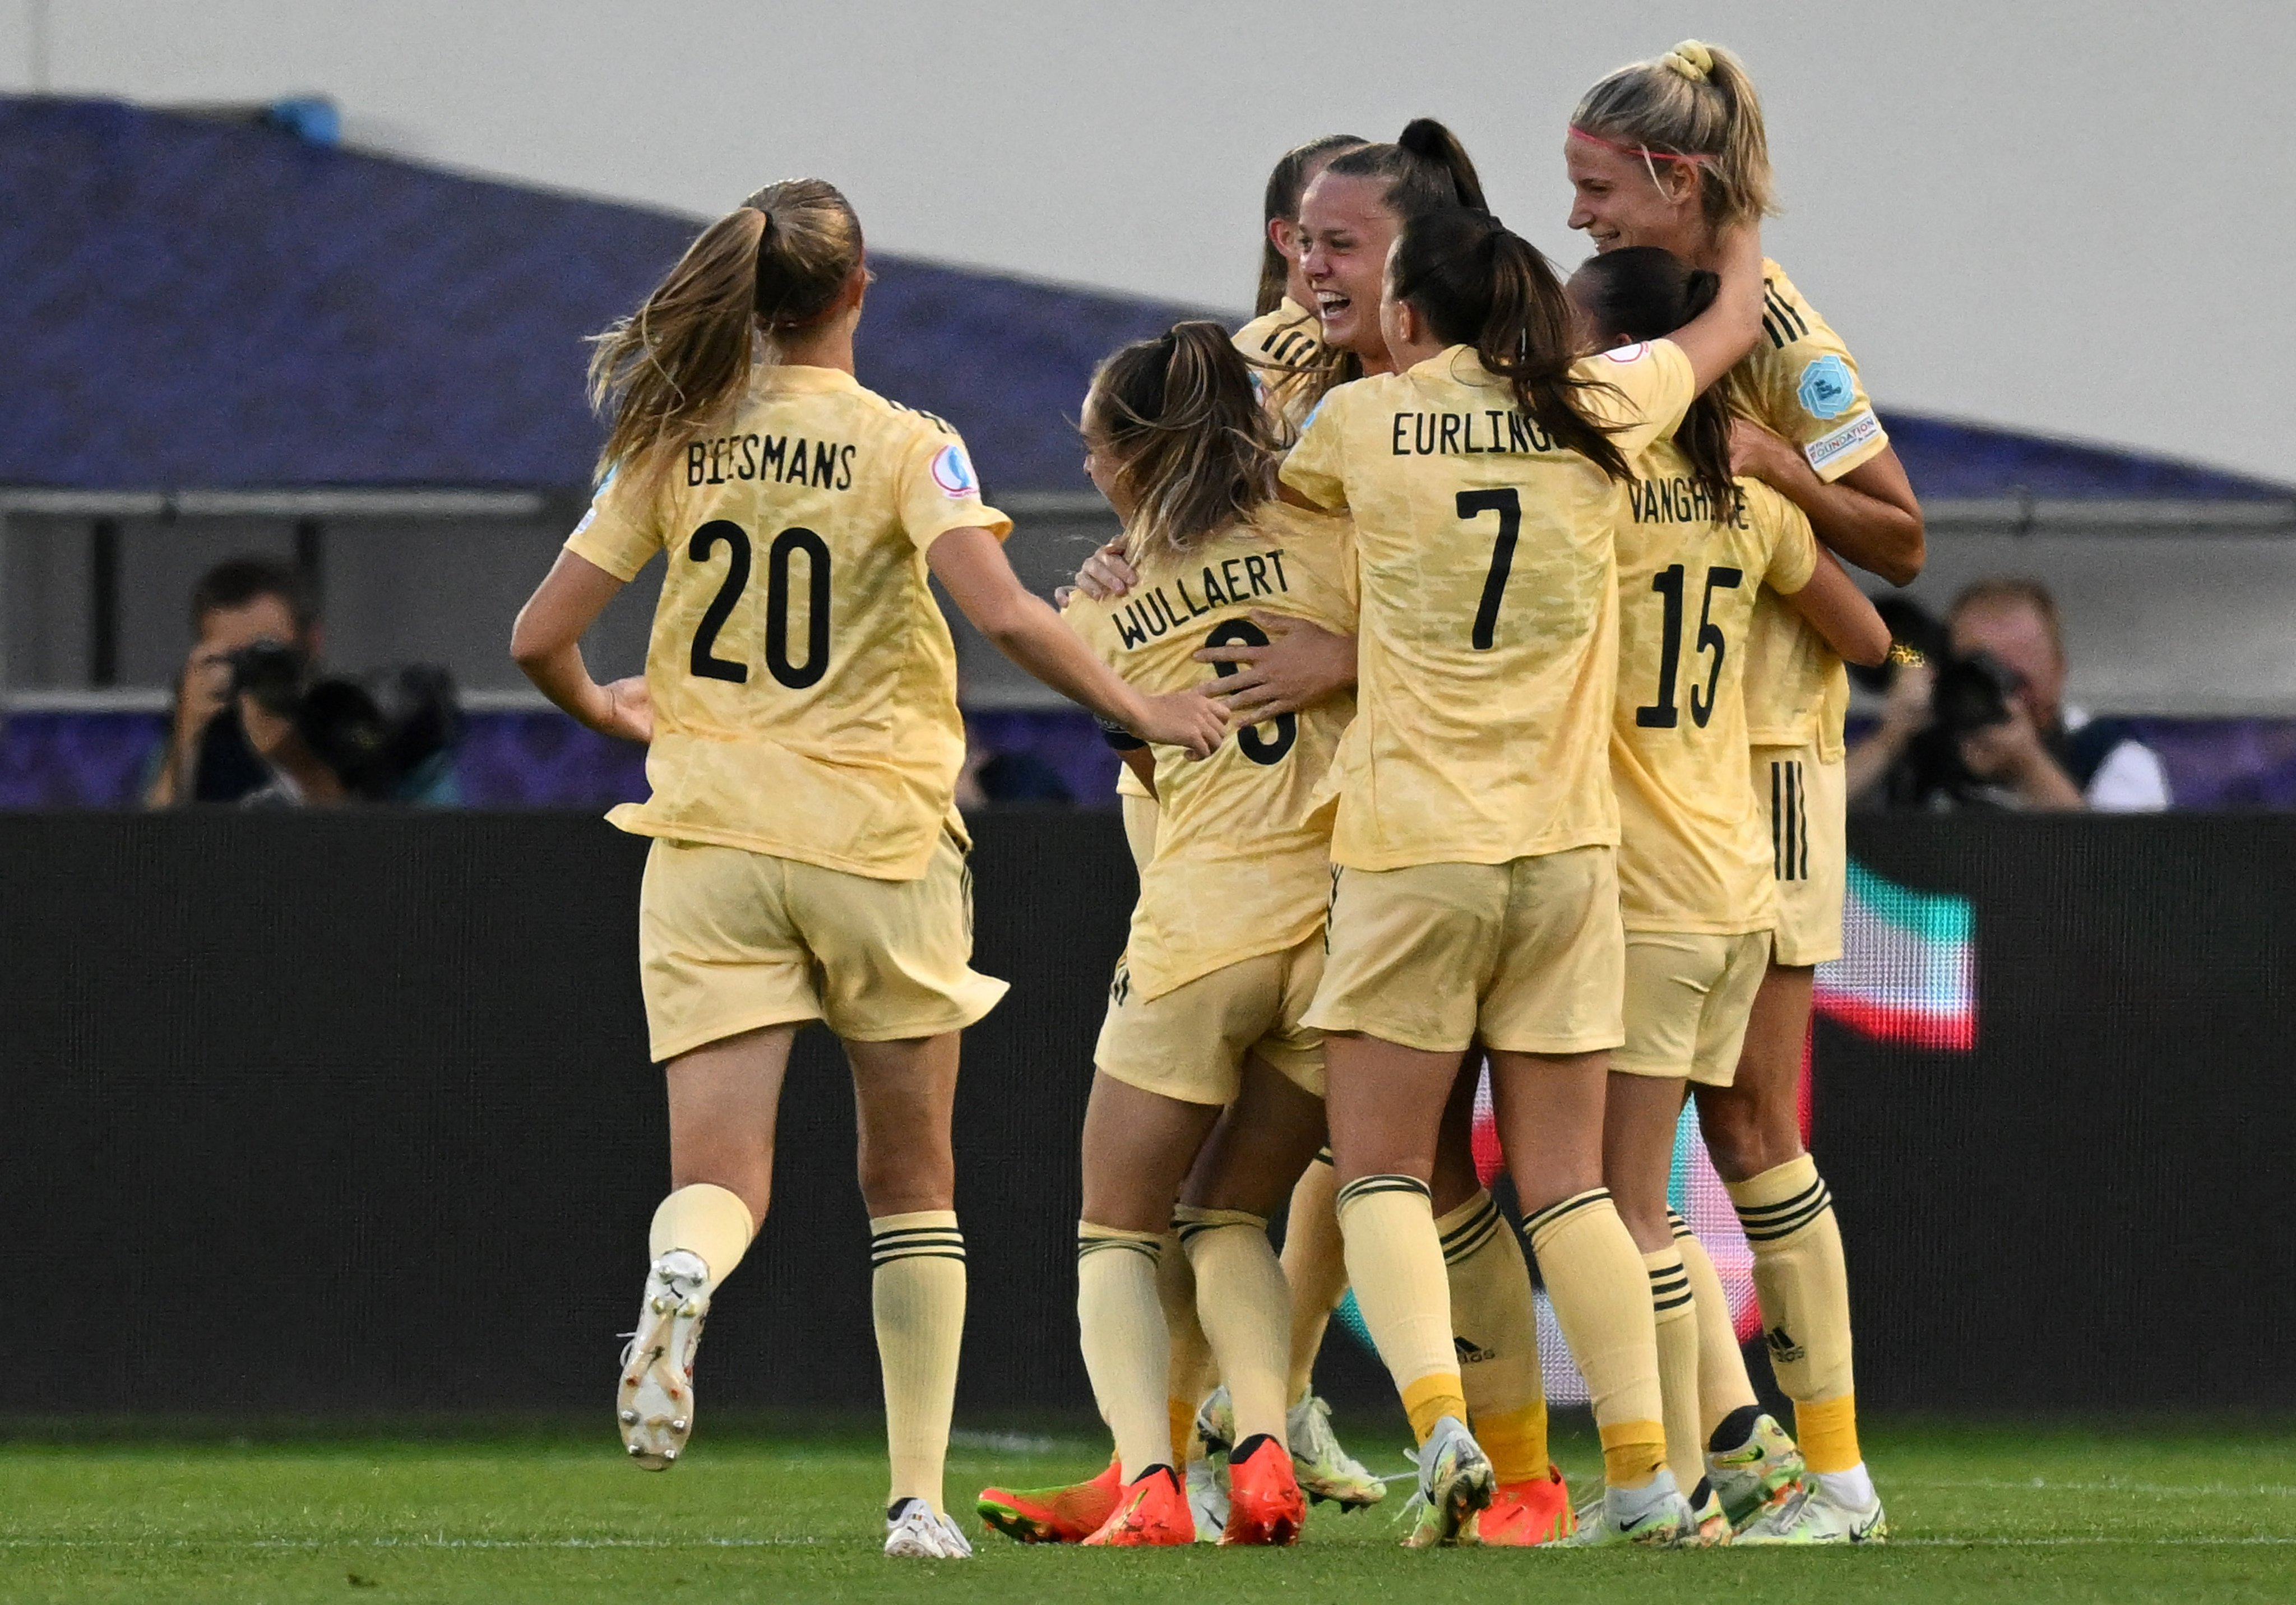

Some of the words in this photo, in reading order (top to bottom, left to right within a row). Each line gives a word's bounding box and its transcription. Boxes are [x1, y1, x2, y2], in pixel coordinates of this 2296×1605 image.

[688, 433, 857, 491] BIESMANS
[1392, 410, 1553, 455] EURLING
[688, 519, 831, 689] 20
[1111, 548, 1289, 650] WULLAERT
[1455, 487, 1521, 650] 7
[1636, 563, 1743, 729] 15
